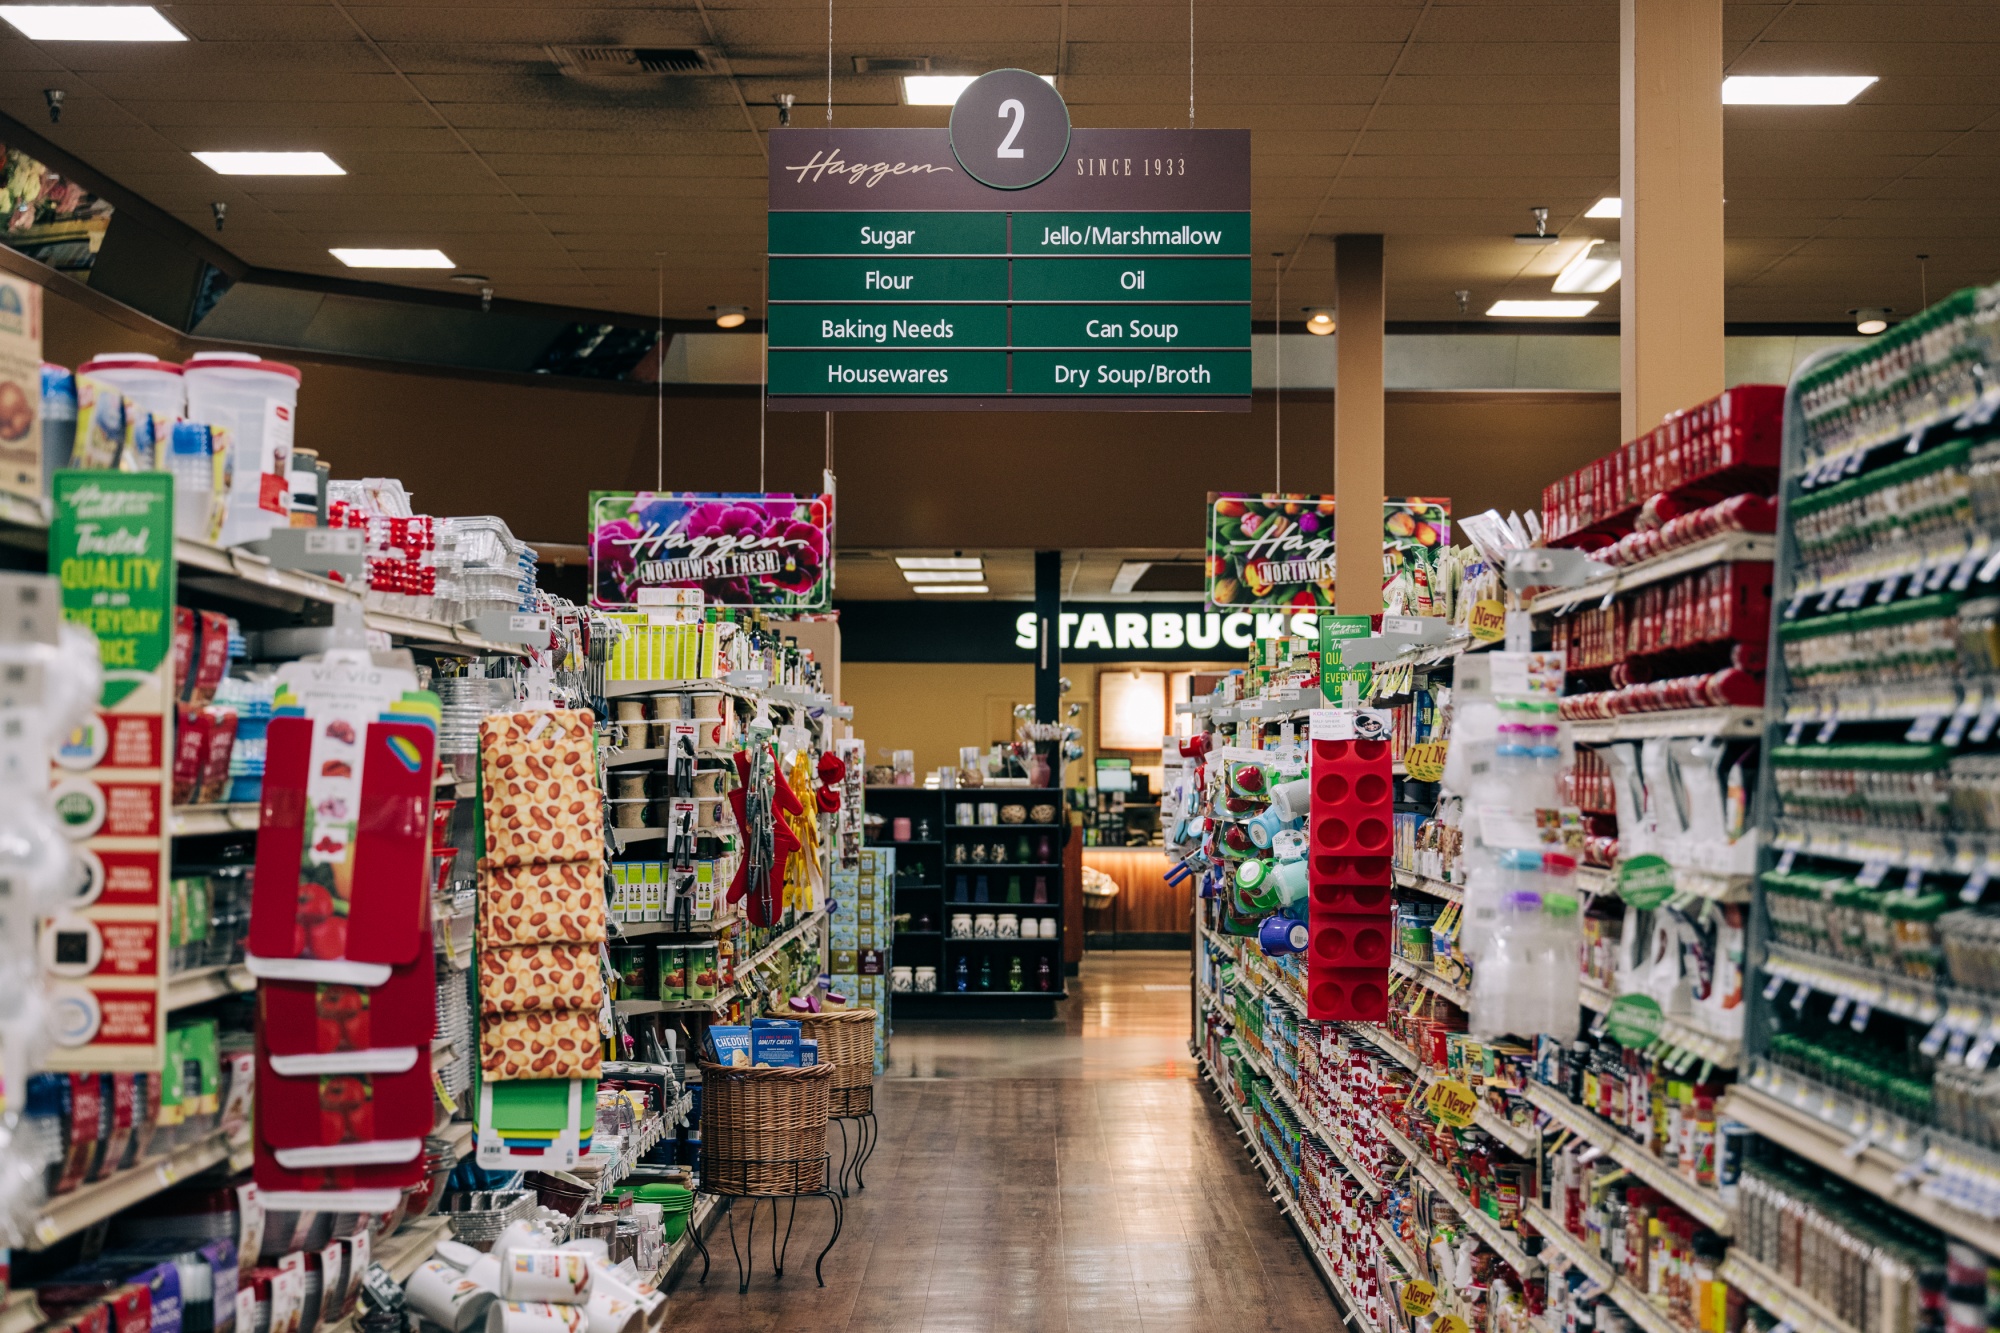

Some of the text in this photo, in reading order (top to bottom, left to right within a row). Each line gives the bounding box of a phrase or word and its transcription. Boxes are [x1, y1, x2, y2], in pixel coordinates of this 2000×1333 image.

[996, 99, 1025, 158] 2
[786, 148, 953, 188] Haggen
[1077, 158, 1186, 176] SINCE 1933
[860, 227, 916, 249] Sugar
[1041, 226, 1222, 246] Jello/Marshmallow
[865, 271, 914, 290] Flour
[1120, 271, 1145, 290] Oil
[822, 319, 954, 342] Baking Needs
[1086, 320, 1179, 342] Can Soup
[828, 364, 949, 384] Housewares
[1055, 364, 1211, 387] Dry Soup/Broth
[612, 520, 810, 563] Haggen
[1230, 521, 1427, 563] Hagn
[61, 557, 161, 589] QUALITY
[645, 552, 776, 581] NORTHWEST FRESH
[1262, 561, 1336, 583] NORTHWES
[1472, 606, 1505, 630] New!
[1015, 612, 1319, 649] STARBUCKS
[1443, 1090, 1476, 1118] New!
[1405, 1283, 1436, 1308] New!
